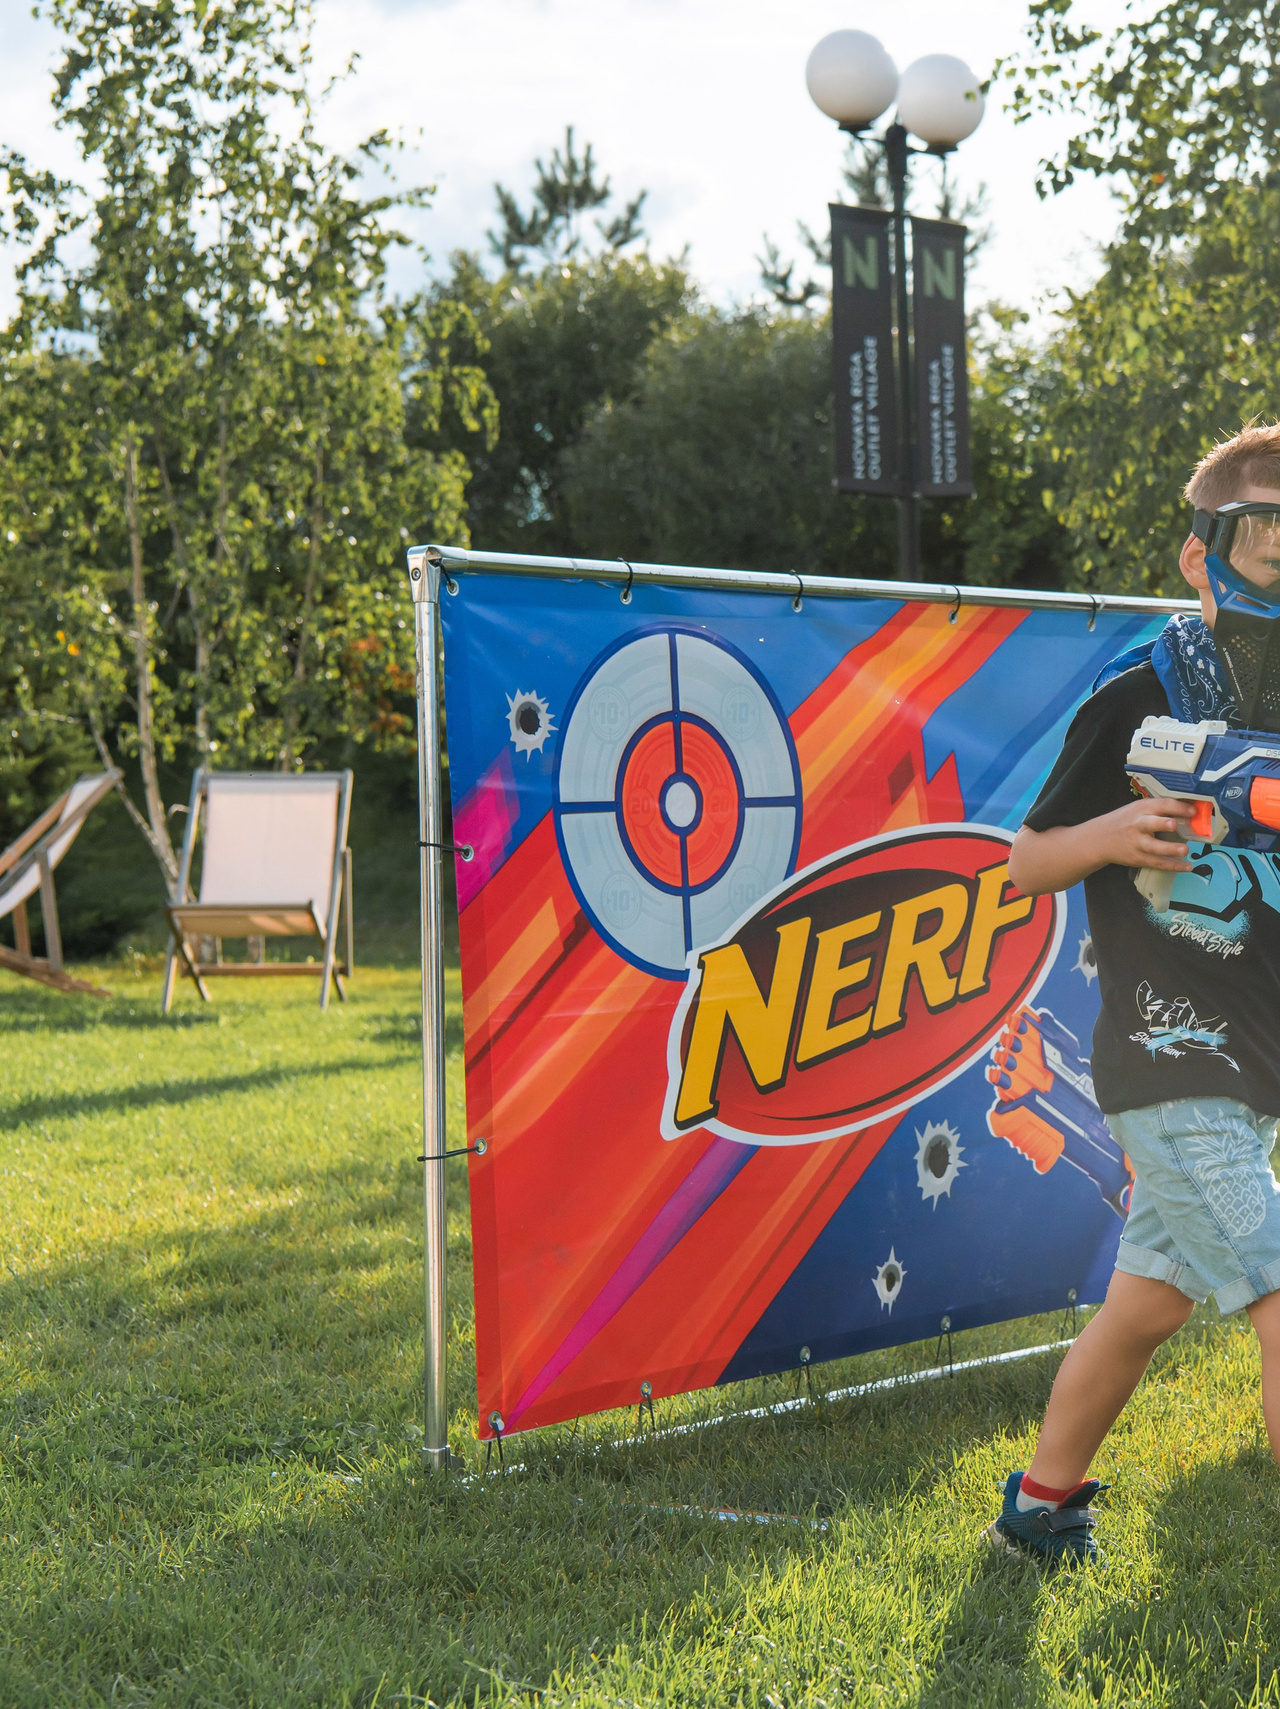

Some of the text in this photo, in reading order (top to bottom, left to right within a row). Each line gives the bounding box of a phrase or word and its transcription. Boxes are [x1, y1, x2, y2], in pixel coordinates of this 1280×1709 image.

[842, 235, 879, 290] N
[922, 249, 956, 300] N
[849, 351, 866, 480] NOVAYA RIGA
[863, 335, 882, 480] OUTLET VILLAGE
[929, 406, 944, 484] NOVAYA
[941, 344, 957, 483] OUTLET VILLAGE
[1140, 737, 1195, 753] ELITE
[675, 861, 1040, 1130] NERF
